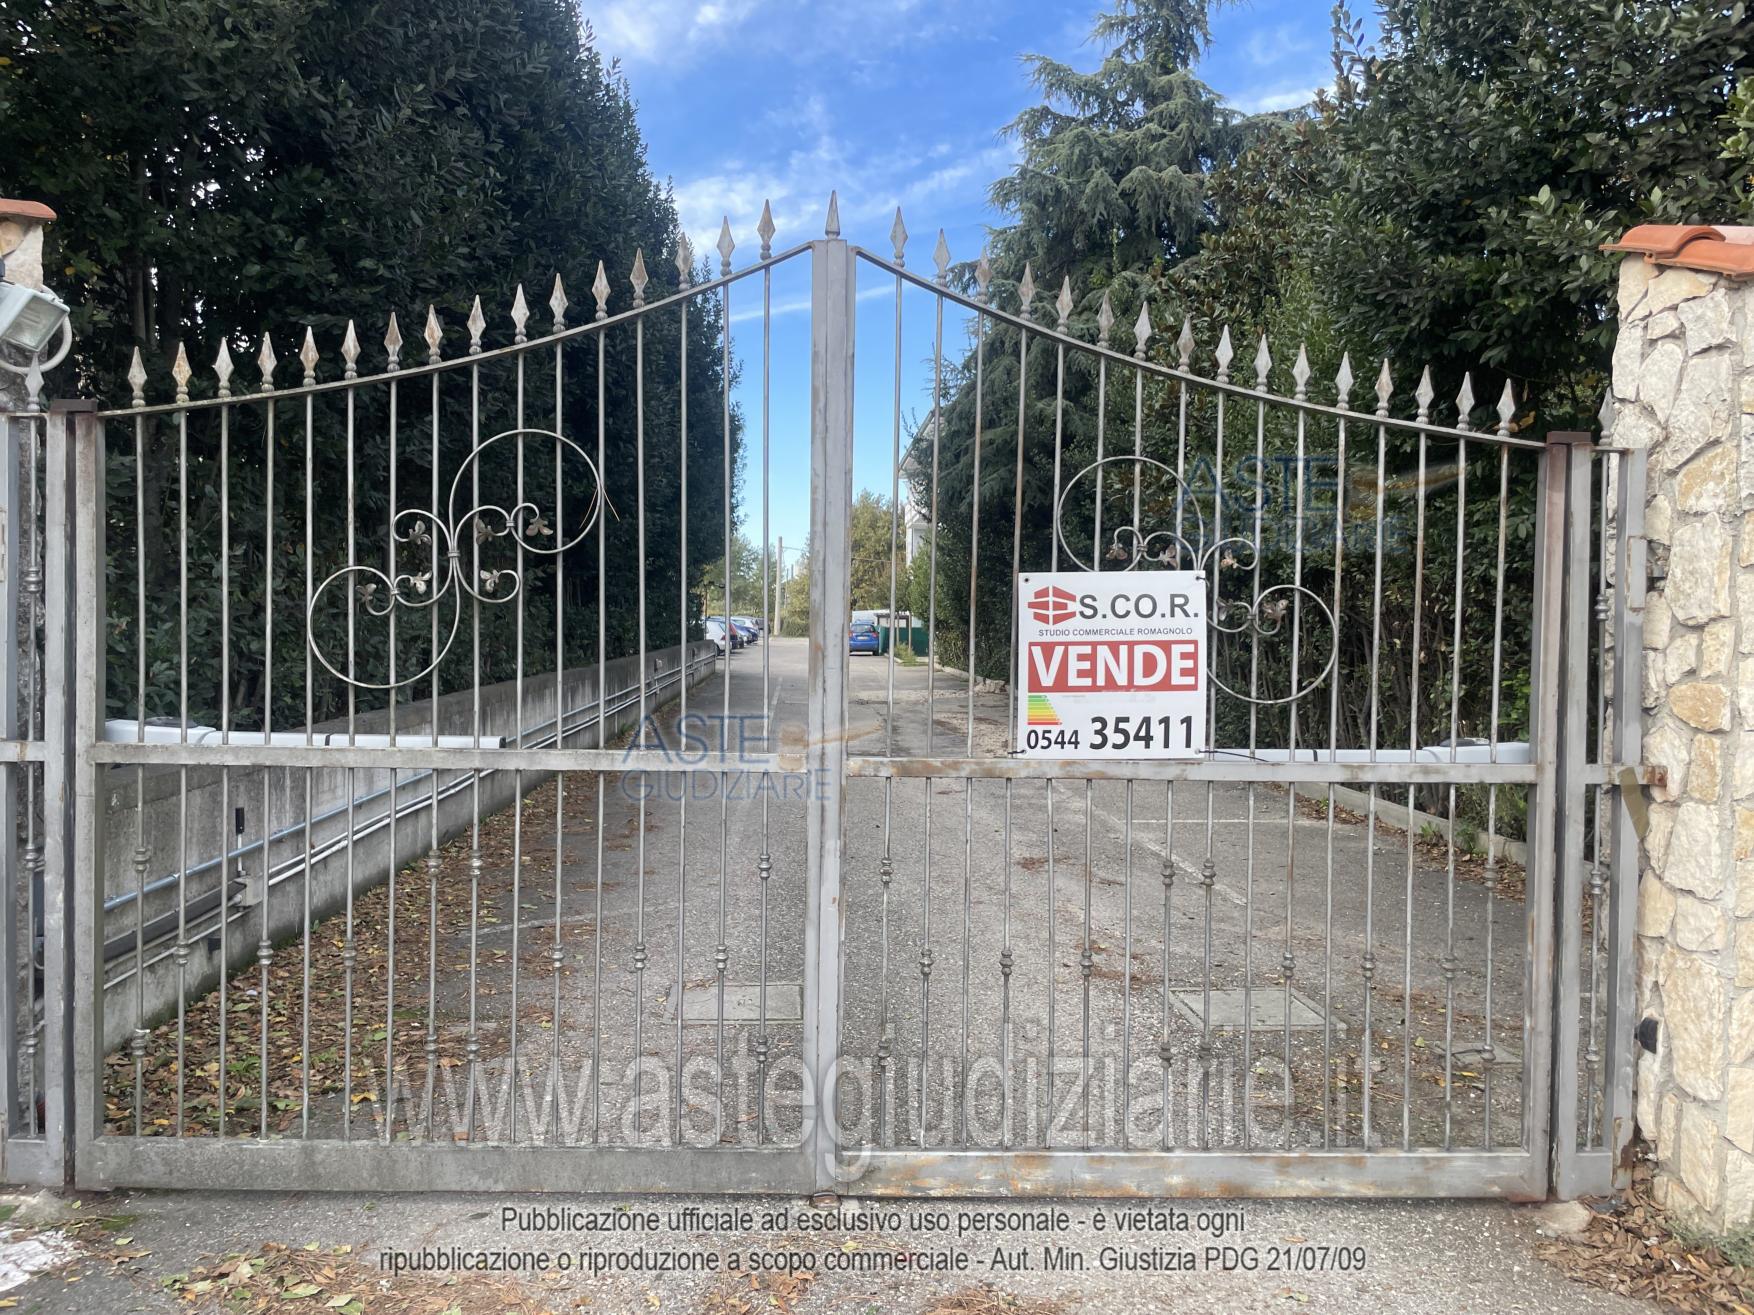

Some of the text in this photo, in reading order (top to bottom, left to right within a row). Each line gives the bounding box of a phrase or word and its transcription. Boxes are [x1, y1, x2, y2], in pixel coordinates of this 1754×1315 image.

[1079, 593, 1199, 619] S.CO.R.
[1038, 627, 1193, 637] STUDIO COMMERCIALE ROMAGNOLO
[1030, 643, 1195, 687] VENDE
[1026, 715, 1193, 750] 0544 35411
